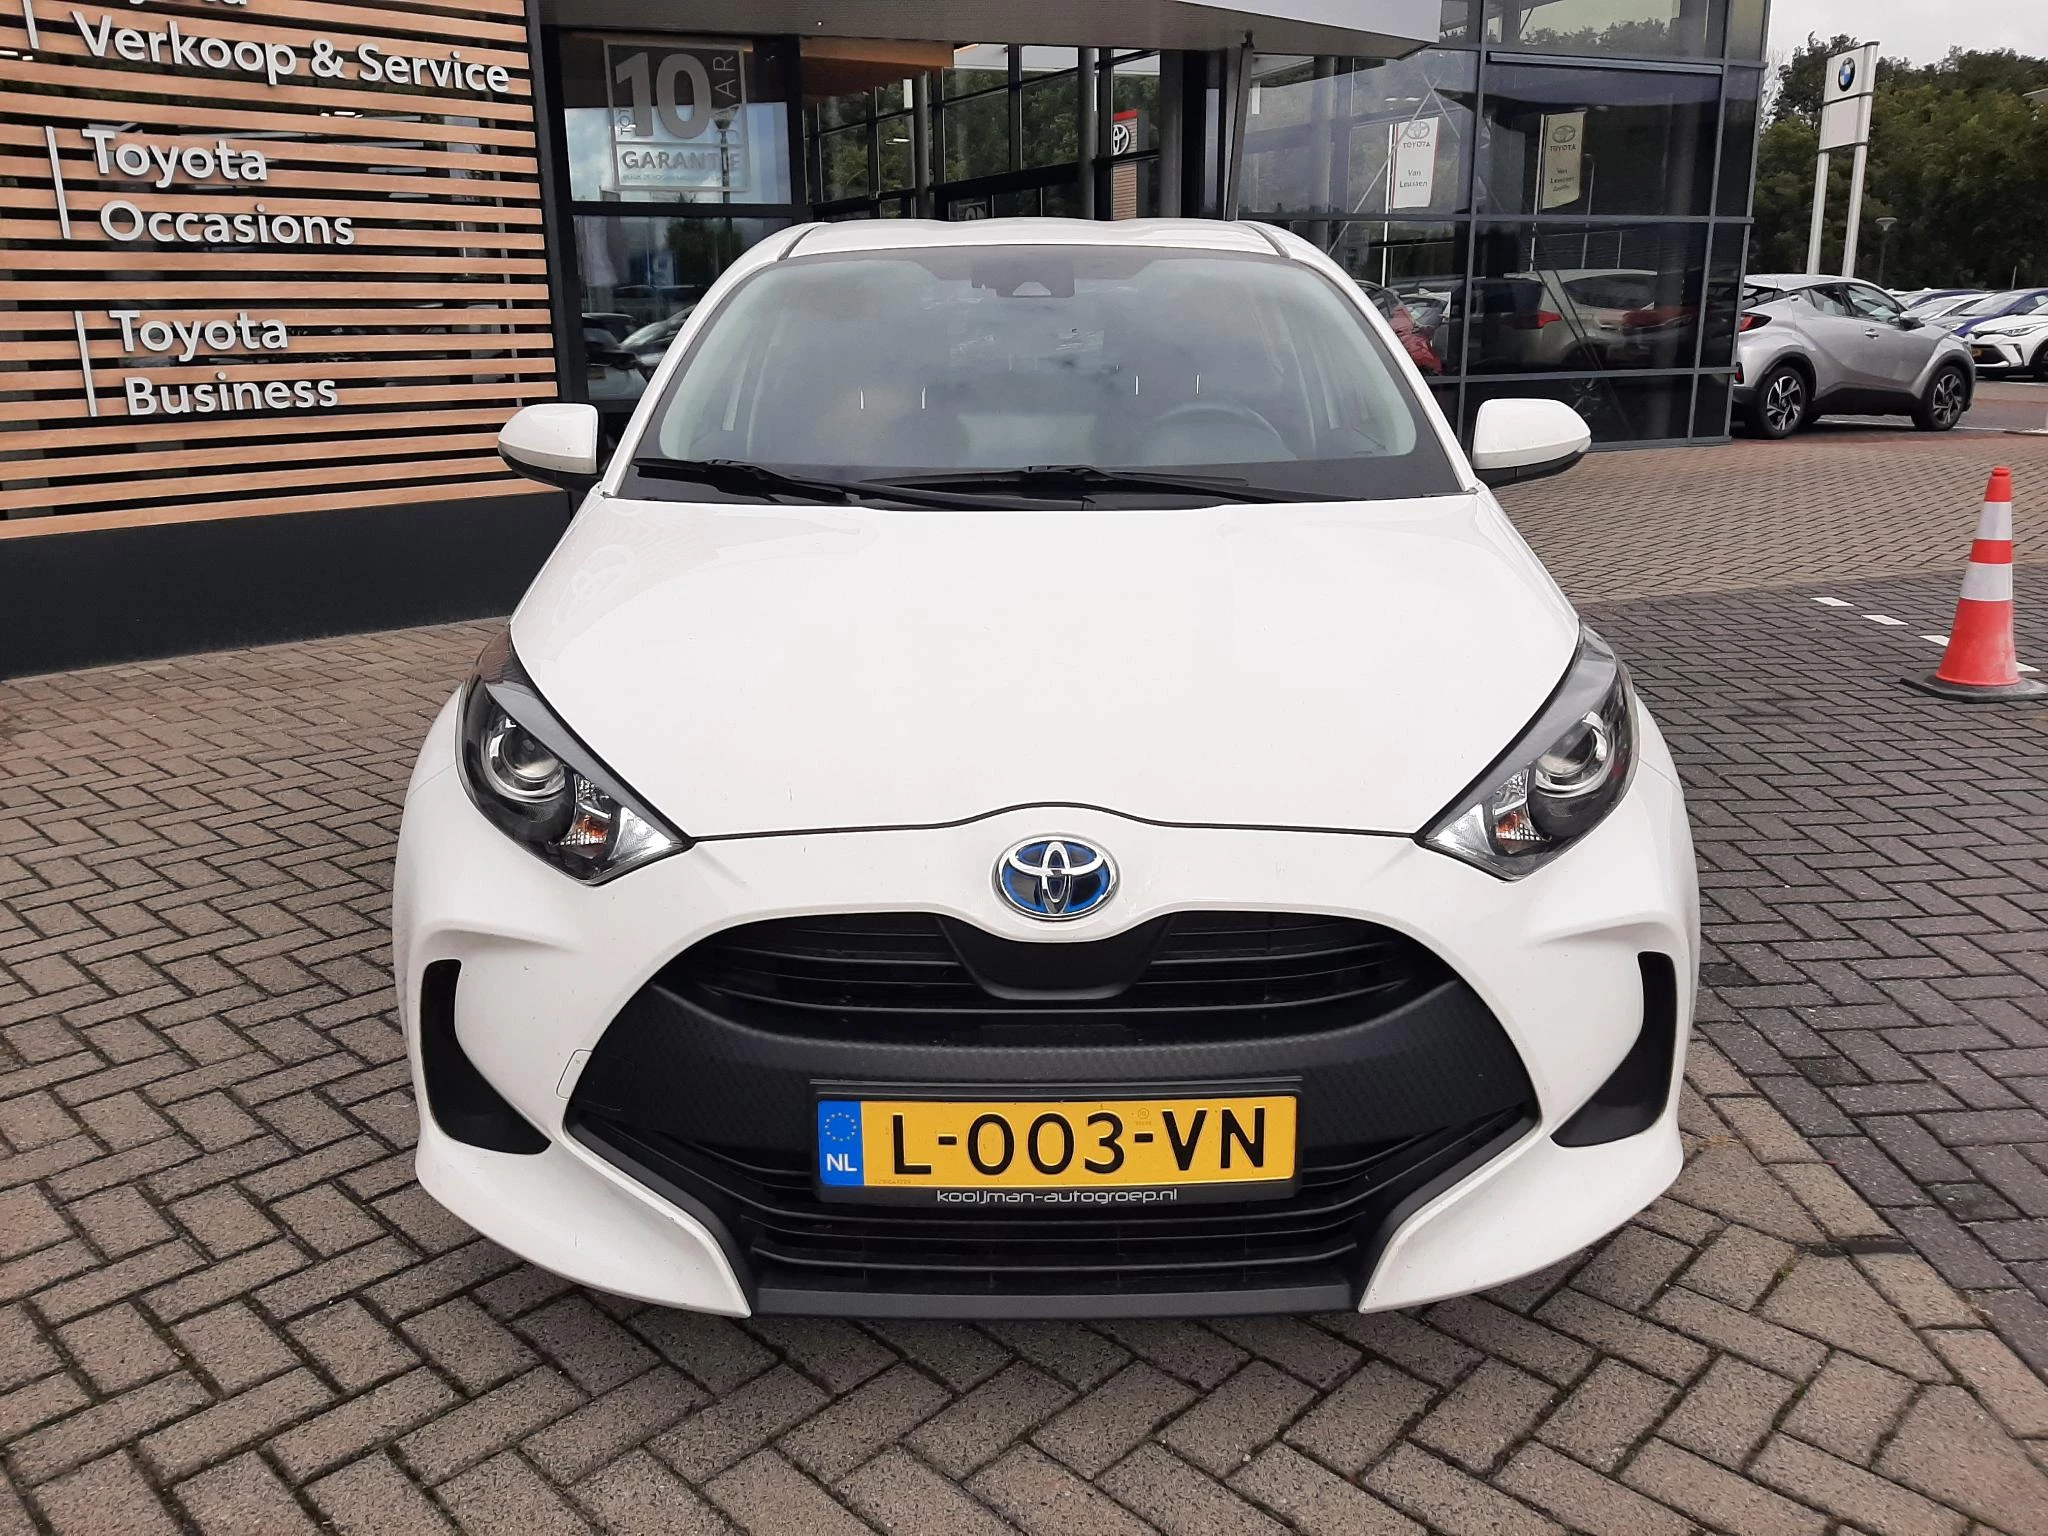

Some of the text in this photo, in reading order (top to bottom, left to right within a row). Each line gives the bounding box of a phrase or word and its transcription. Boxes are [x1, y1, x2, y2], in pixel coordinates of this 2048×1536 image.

[72, 10, 511, 93] Verkoop & Service
[615, 51, 712, 140] 10
[82, 128, 268, 189] Toyota
[621, 150, 741, 172] GARANTE
[1403, 141, 1431, 149] TOYOTA
[1550, 144, 1576, 152] TOYOTA
[100, 200, 355, 245] Occasions
[108, 309, 289, 363] Toyota
[125, 371, 338, 416] Business
[826, 1152, 857, 1172] NL
[892, 1107, 1266, 1176] L-003-VN
